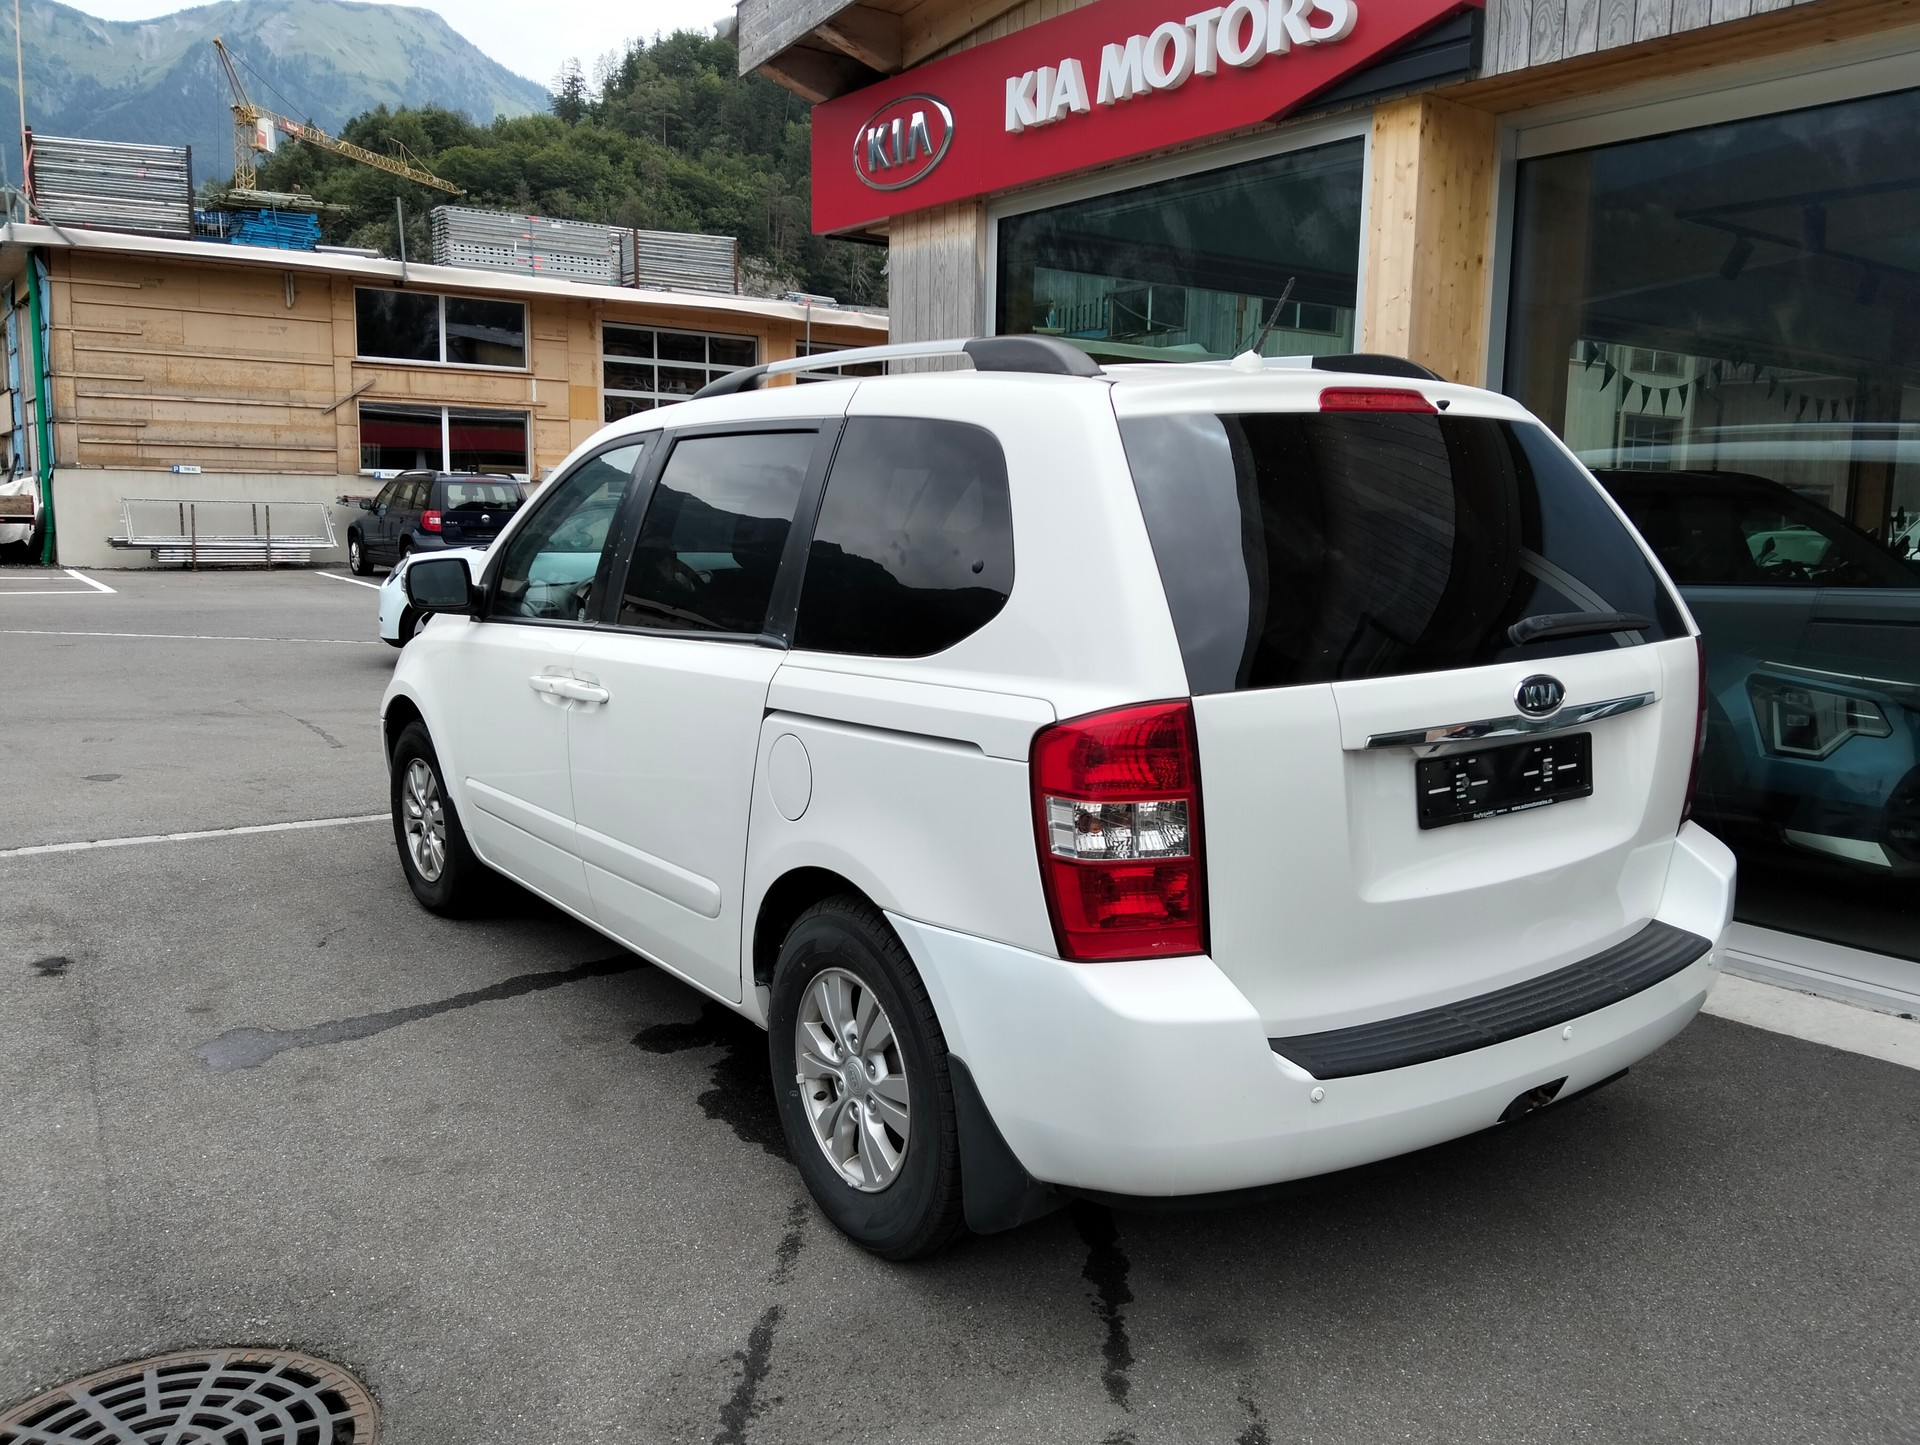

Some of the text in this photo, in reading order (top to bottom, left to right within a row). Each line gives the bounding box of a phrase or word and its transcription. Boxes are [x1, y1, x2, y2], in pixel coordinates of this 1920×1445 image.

[1005, 0, 1359, 134] KIA MOTORS
[867, 111, 933, 172] KIA
[1524, 683, 1560, 707] KIA
